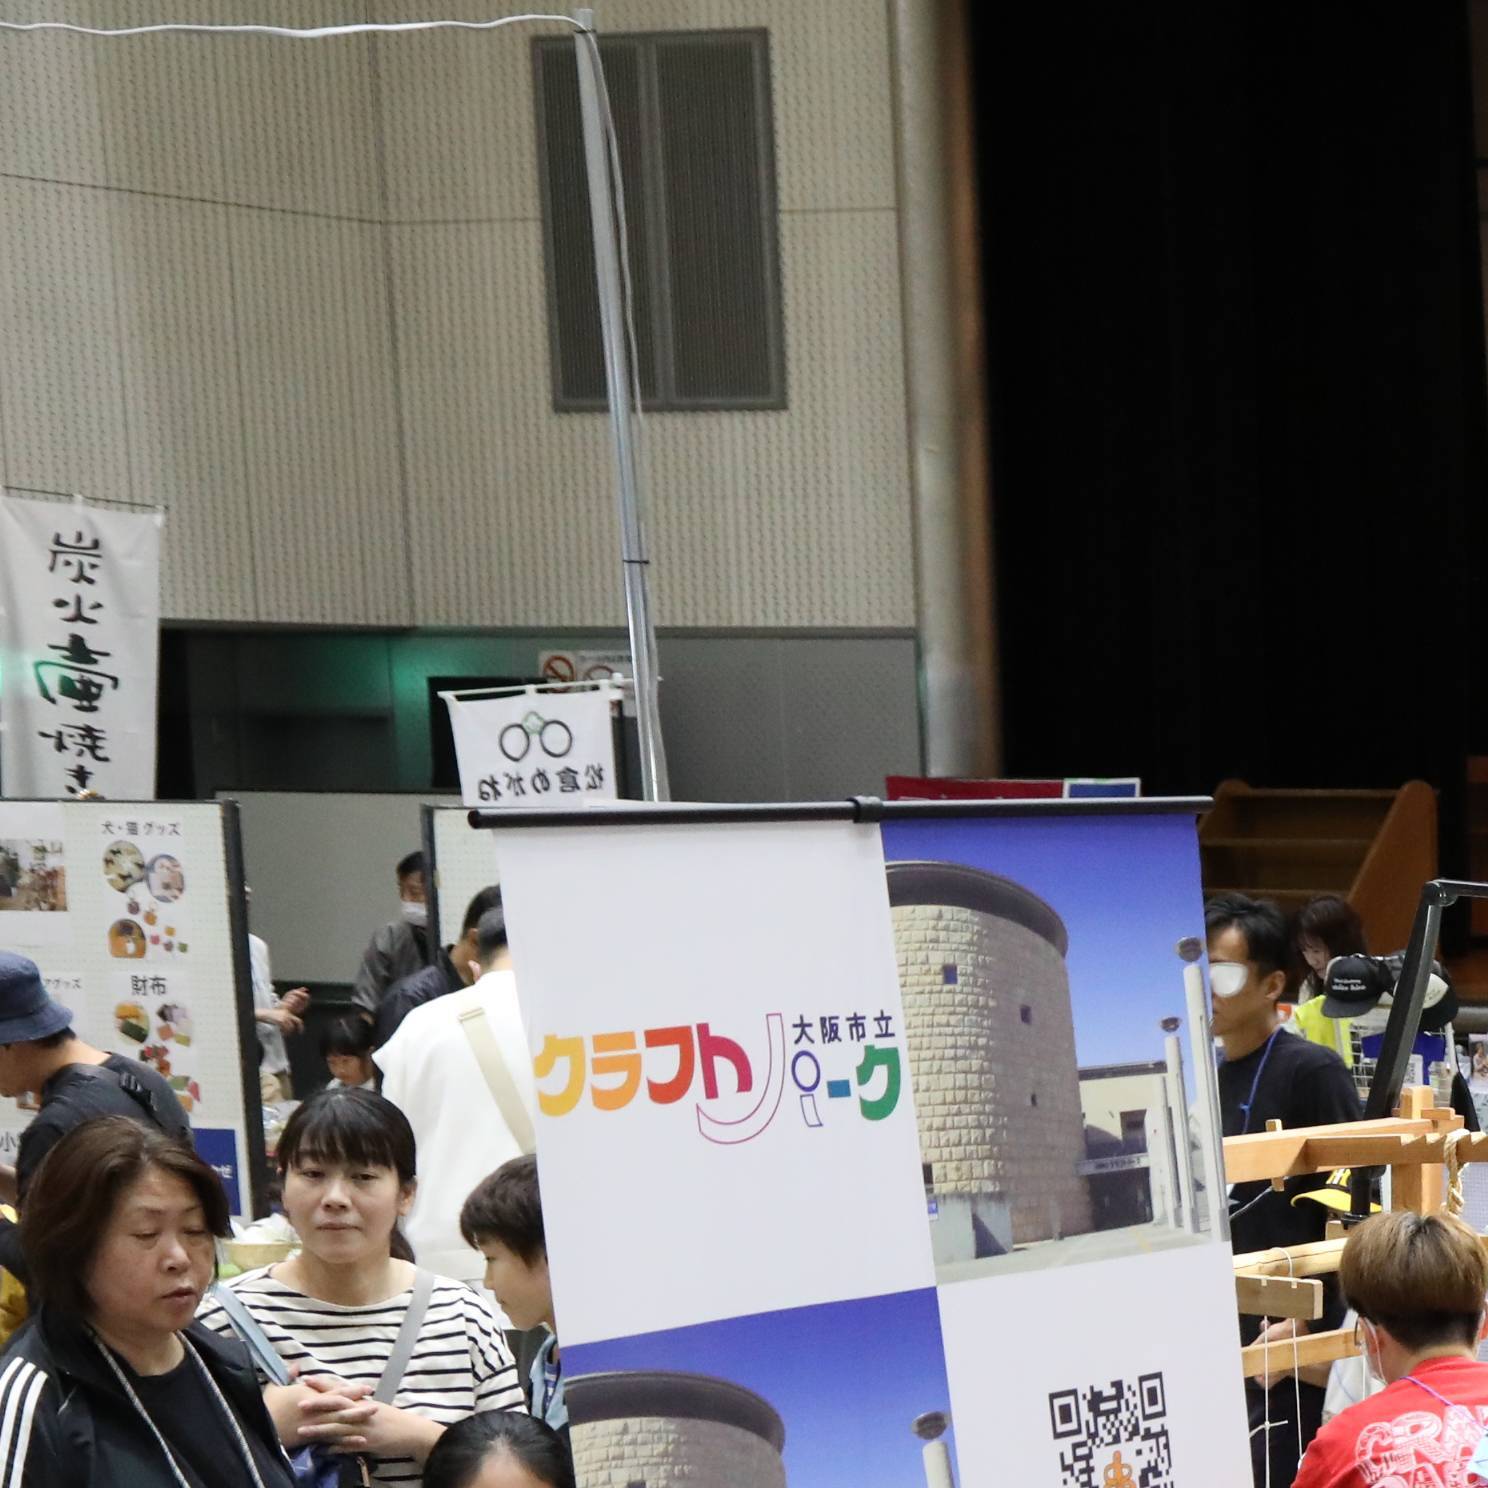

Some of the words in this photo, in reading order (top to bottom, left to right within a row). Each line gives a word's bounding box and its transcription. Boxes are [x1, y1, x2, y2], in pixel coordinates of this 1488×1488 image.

[131, 975, 168, 997] 財布
[792, 1011, 896, 1046] 大阪市立
